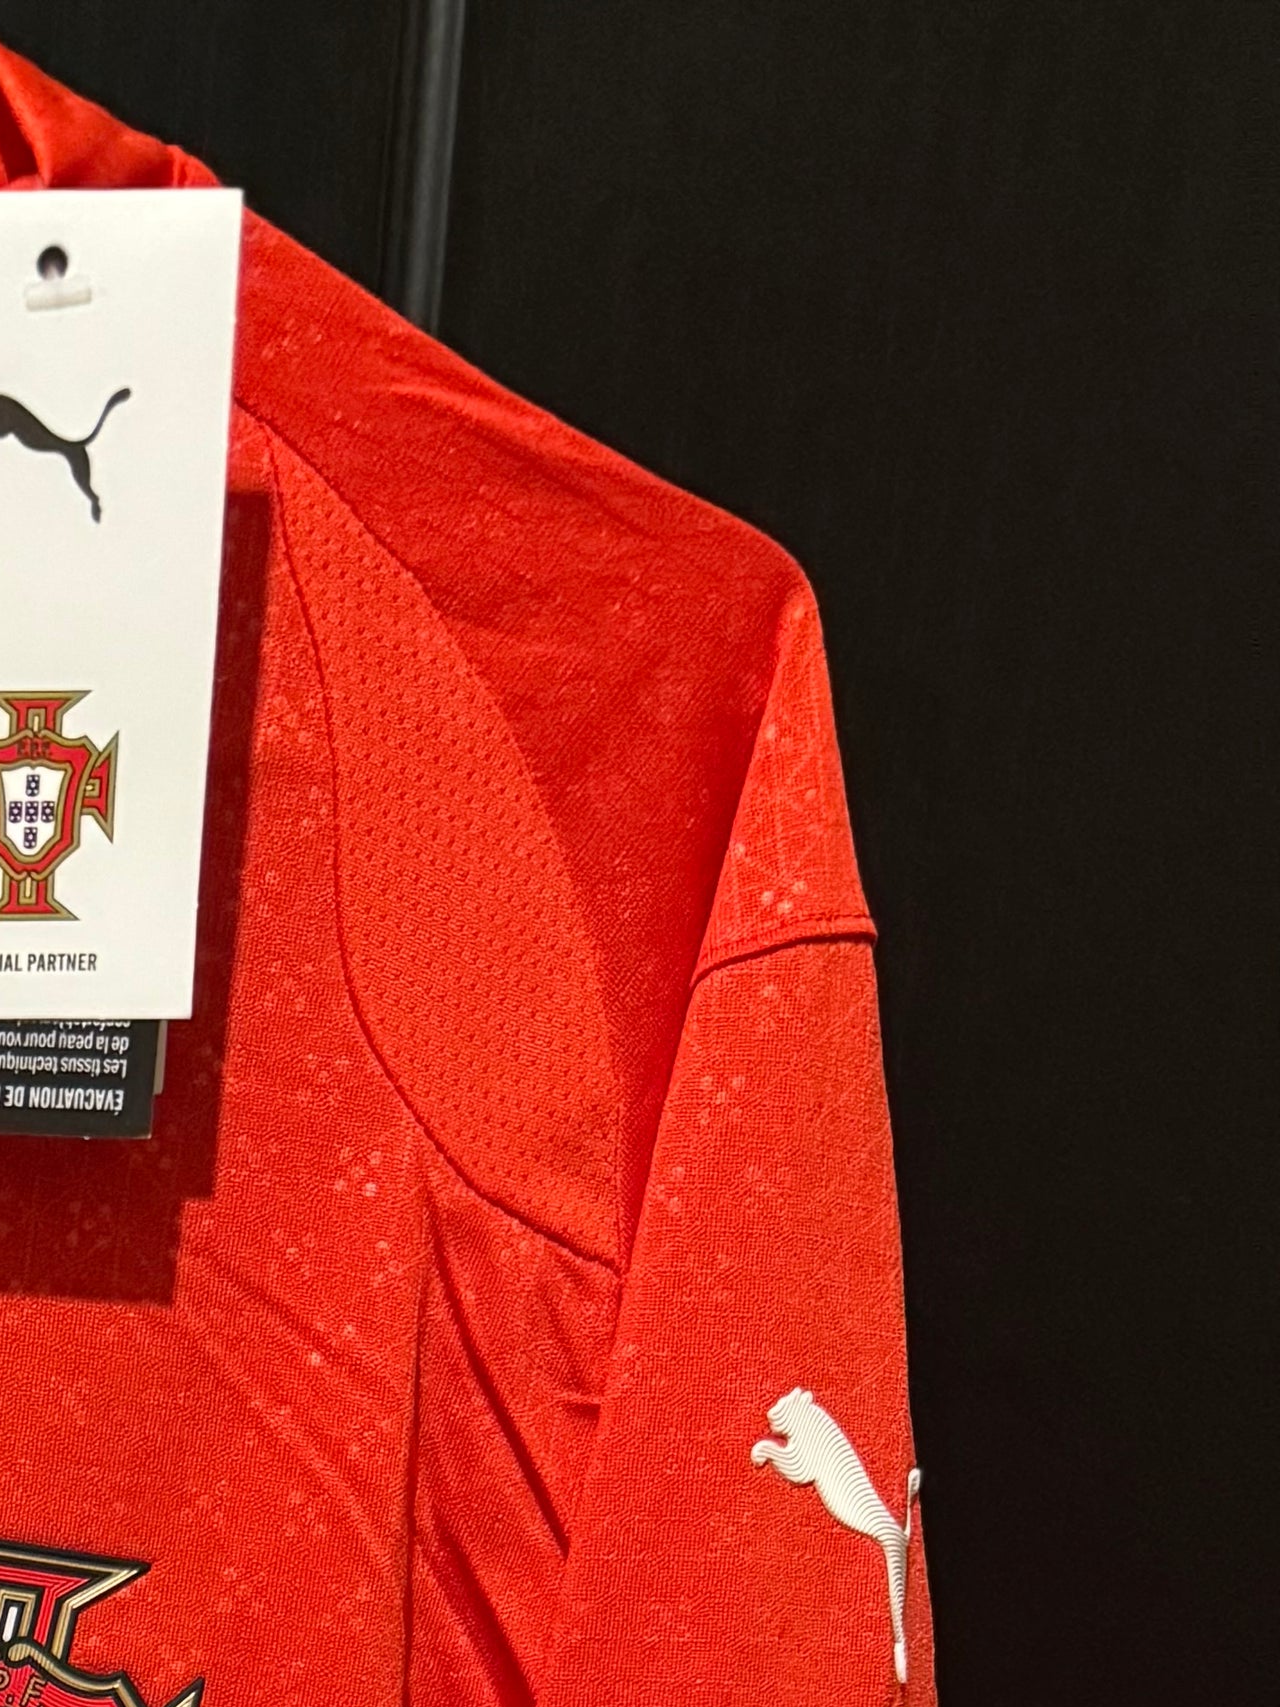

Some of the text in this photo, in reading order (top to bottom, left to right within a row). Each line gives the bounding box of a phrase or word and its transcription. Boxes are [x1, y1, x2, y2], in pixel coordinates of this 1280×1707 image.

[27, 953, 98, 972] PARTNER
[23, 1030, 56, 1048] pour
[57, 1031, 93, 1049] peau
[94, 1034, 109, 1052] la
[111, 1034, 130, 1053] de
[61, 1057, 101, 1077] tissus
[103, 1058, 128, 1079] Les
[4, 1085, 24, 1108] DE
[29, 1086, 124, 1116] ÉVACUATION
